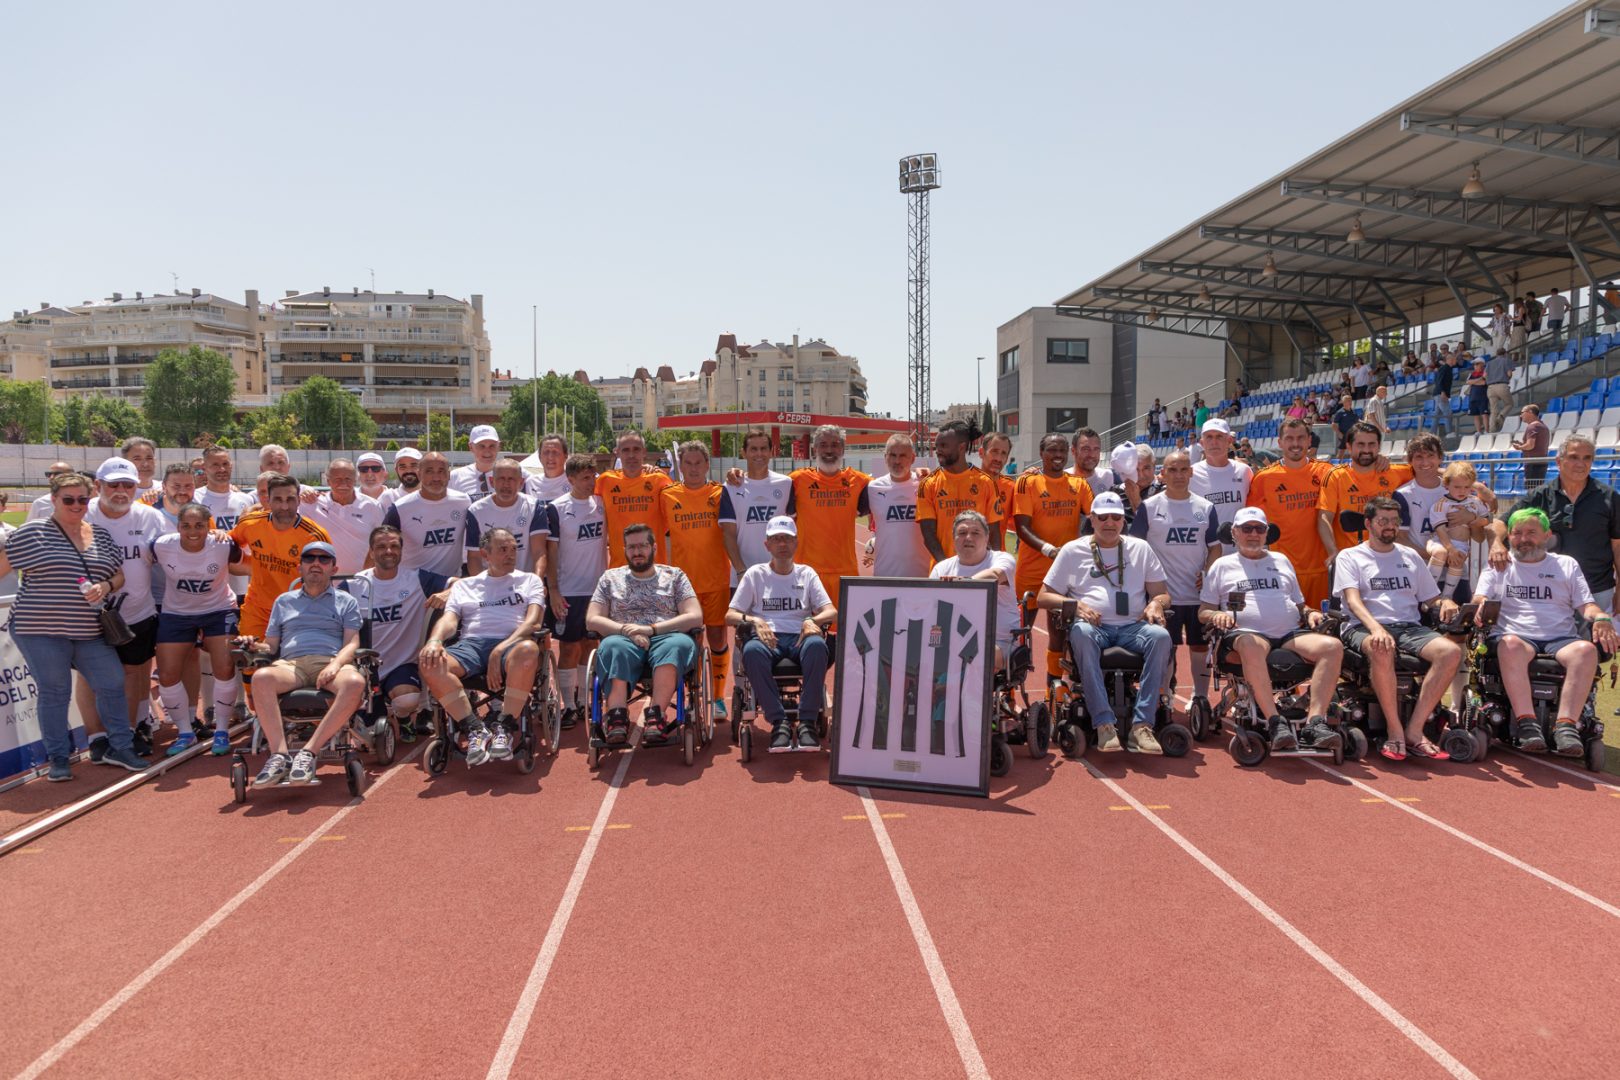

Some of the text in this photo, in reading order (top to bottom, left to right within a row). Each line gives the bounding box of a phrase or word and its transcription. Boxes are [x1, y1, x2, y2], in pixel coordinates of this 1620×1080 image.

[786, 413, 811, 424] CEPSA
[612, 495, 654, 505] Emirates
[810, 489, 851, 499] Emirates
[1224, 490, 1242, 503] ELA
[674, 511, 717, 522] Emirates
[746, 506, 777, 522] AFE
[887, 505, 917, 521] AFE
[423, 527, 456, 547] AFE
[577, 522, 604, 541] AFE
[1166, 527, 1200, 544] AFE
[252, 551, 297, 568] Emirates
[176, 579, 214, 594] AFE
[1258, 578, 1279, 589] ELA
[1389, 576, 1411, 590] ELA
[1528, 585, 1553, 600] ELA
[782, 597, 803, 611] ELA
[371, 604, 402, 622] AFE
